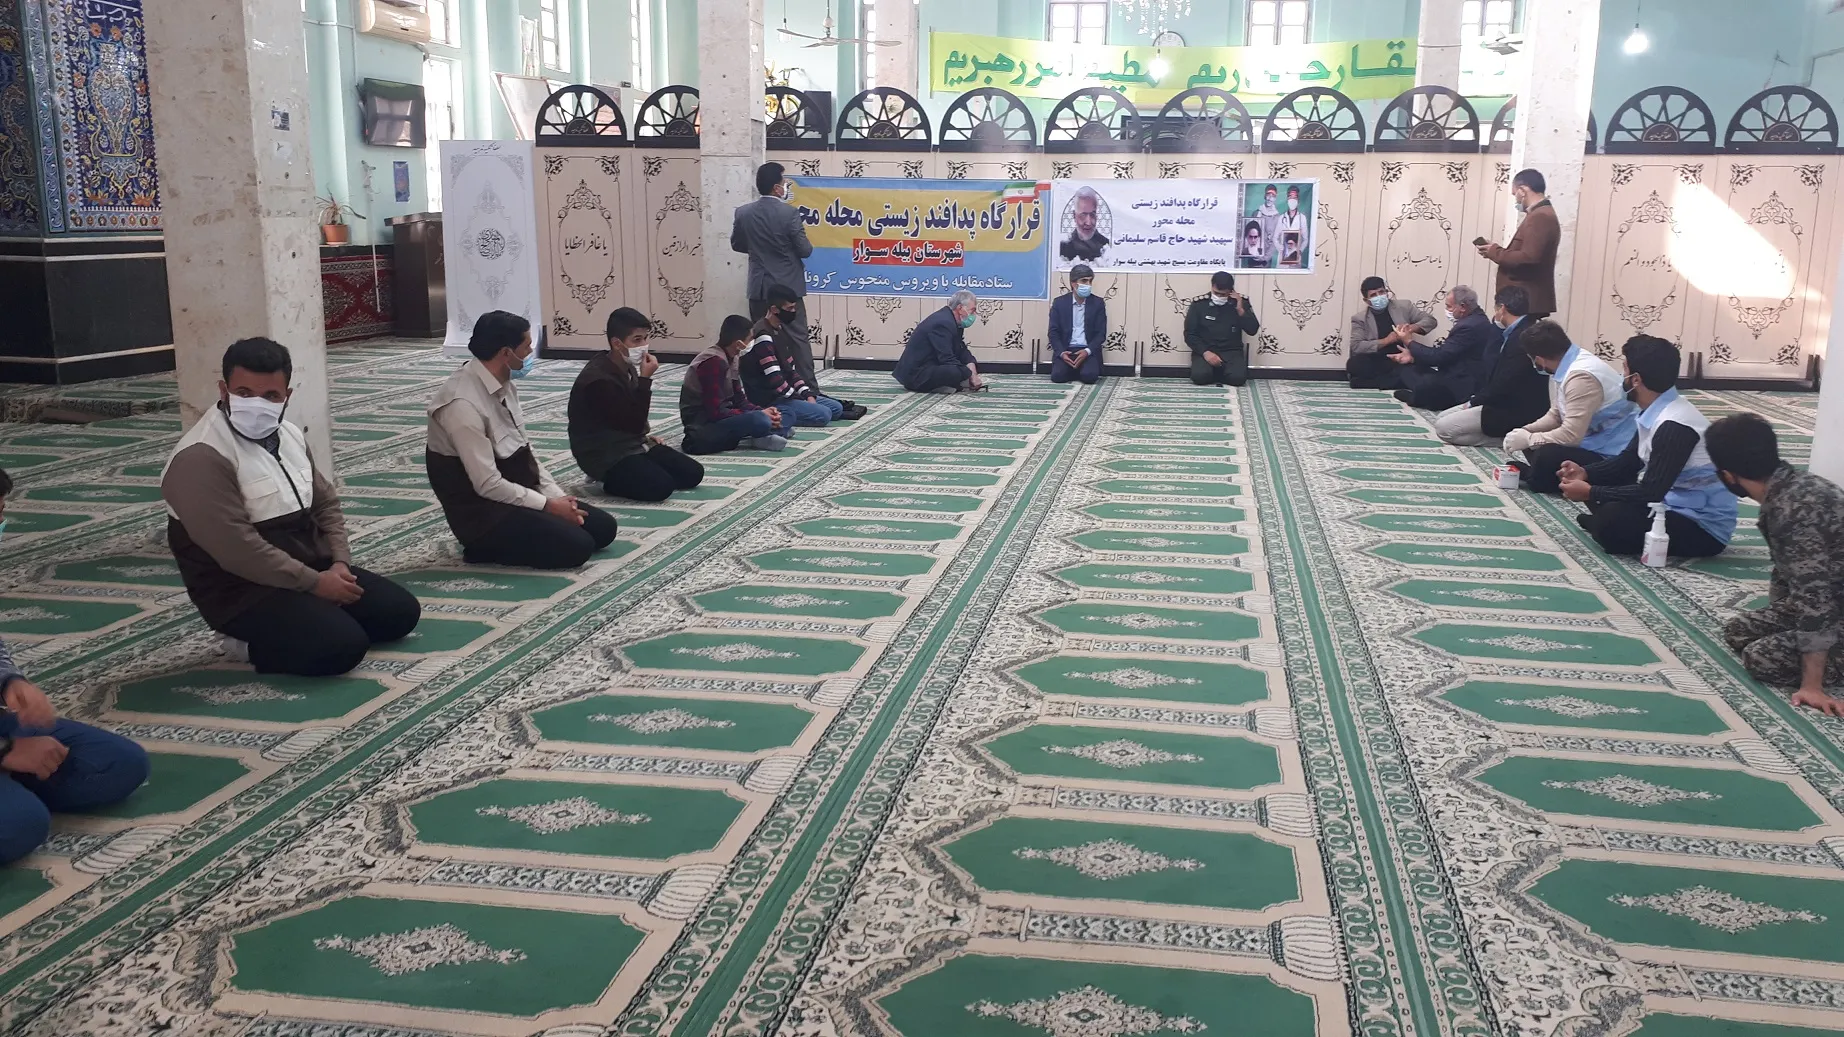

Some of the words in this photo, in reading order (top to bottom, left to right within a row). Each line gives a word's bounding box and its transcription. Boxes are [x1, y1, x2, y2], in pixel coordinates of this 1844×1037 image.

[1131, 199, 1158, 210] زیستی
[1160, 197, 1186, 210] پدافند
[1188, 197, 1218, 210] قرارگاه
[798, 204, 820, 227] مح
[824, 197, 863, 227] محله
[867, 203, 920, 239] زیستی
[924, 197, 976, 241] پدافند
[980, 199, 1041, 240] قرارگاه
[1152, 217, 1173, 228] محور
[1175, 216, 1195, 225] محله
[564, 236, 586, 256] الخطایا
[584, 233, 602, 254] غافر
[662, 235, 689, 257] الرازقین
[1113, 233, 1146, 246] سلیمانی
[1147, 233, 1167, 246] قاسم
[1168, 234, 1186, 246] حاج
[1187, 234, 1207, 246] شهید
[1209, 235, 1233, 246] سپهبد
[852, 239, 890, 263] سوار
[891, 240, 912, 263] بیله
[913, 240, 964, 264] شهرستان
[1112, 258, 1126, 267] سوار
[1126, 257, 1137, 266] بیله
[1137, 258, 1156, 267] بهشتی
[1157, 258, 1171, 266] شهید
[1171, 259, 1187, 267] بسیج
[1187, 258, 1209, 267] مقاومت
[1209, 258, 1226, 267] پایگاه
[804, 270, 837, 290] کرونا
[839, 273, 890, 291] منحوس
[892, 275, 939, 292] ویروس
[941, 274, 949, 290] با
[951, 273, 985, 291] مقابله
[986, 275, 1013, 289] ستاد
